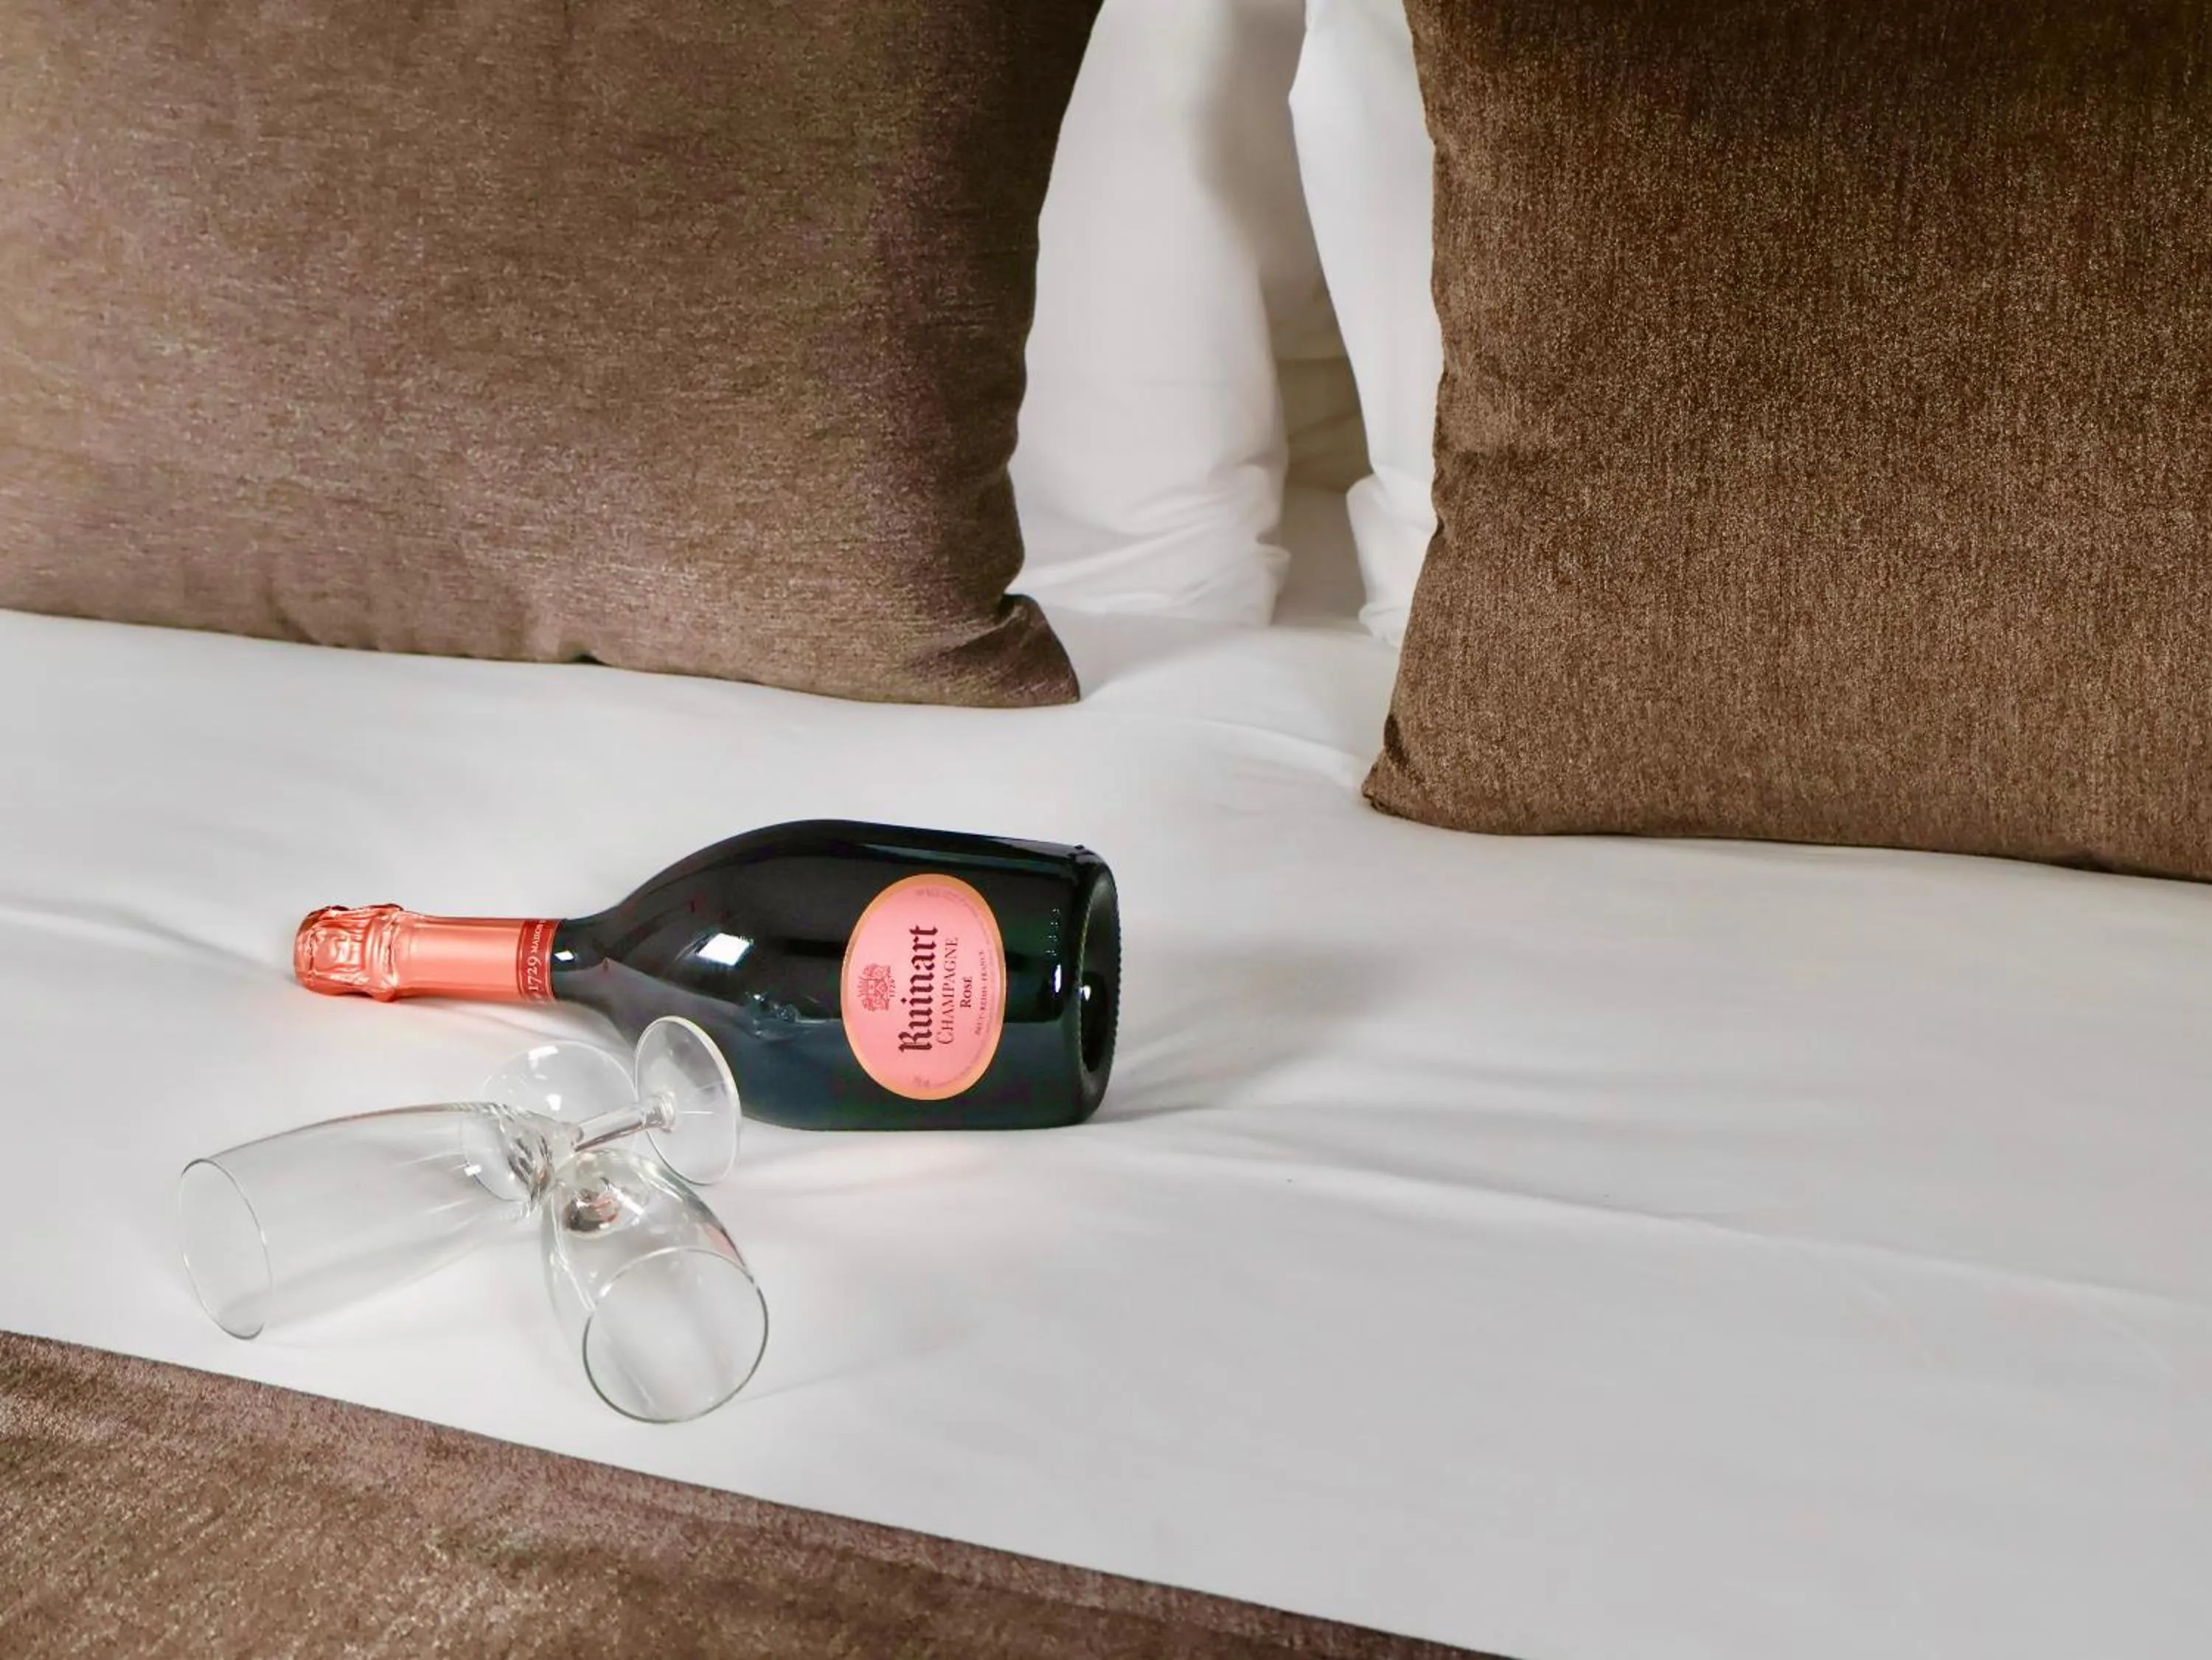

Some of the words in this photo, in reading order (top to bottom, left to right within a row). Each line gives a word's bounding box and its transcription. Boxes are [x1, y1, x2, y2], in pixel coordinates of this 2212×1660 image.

[527, 956, 542, 991] 1729
[898, 924, 939, 1053] Ruinart
[936, 937, 959, 1045] CHAMPAGNE
